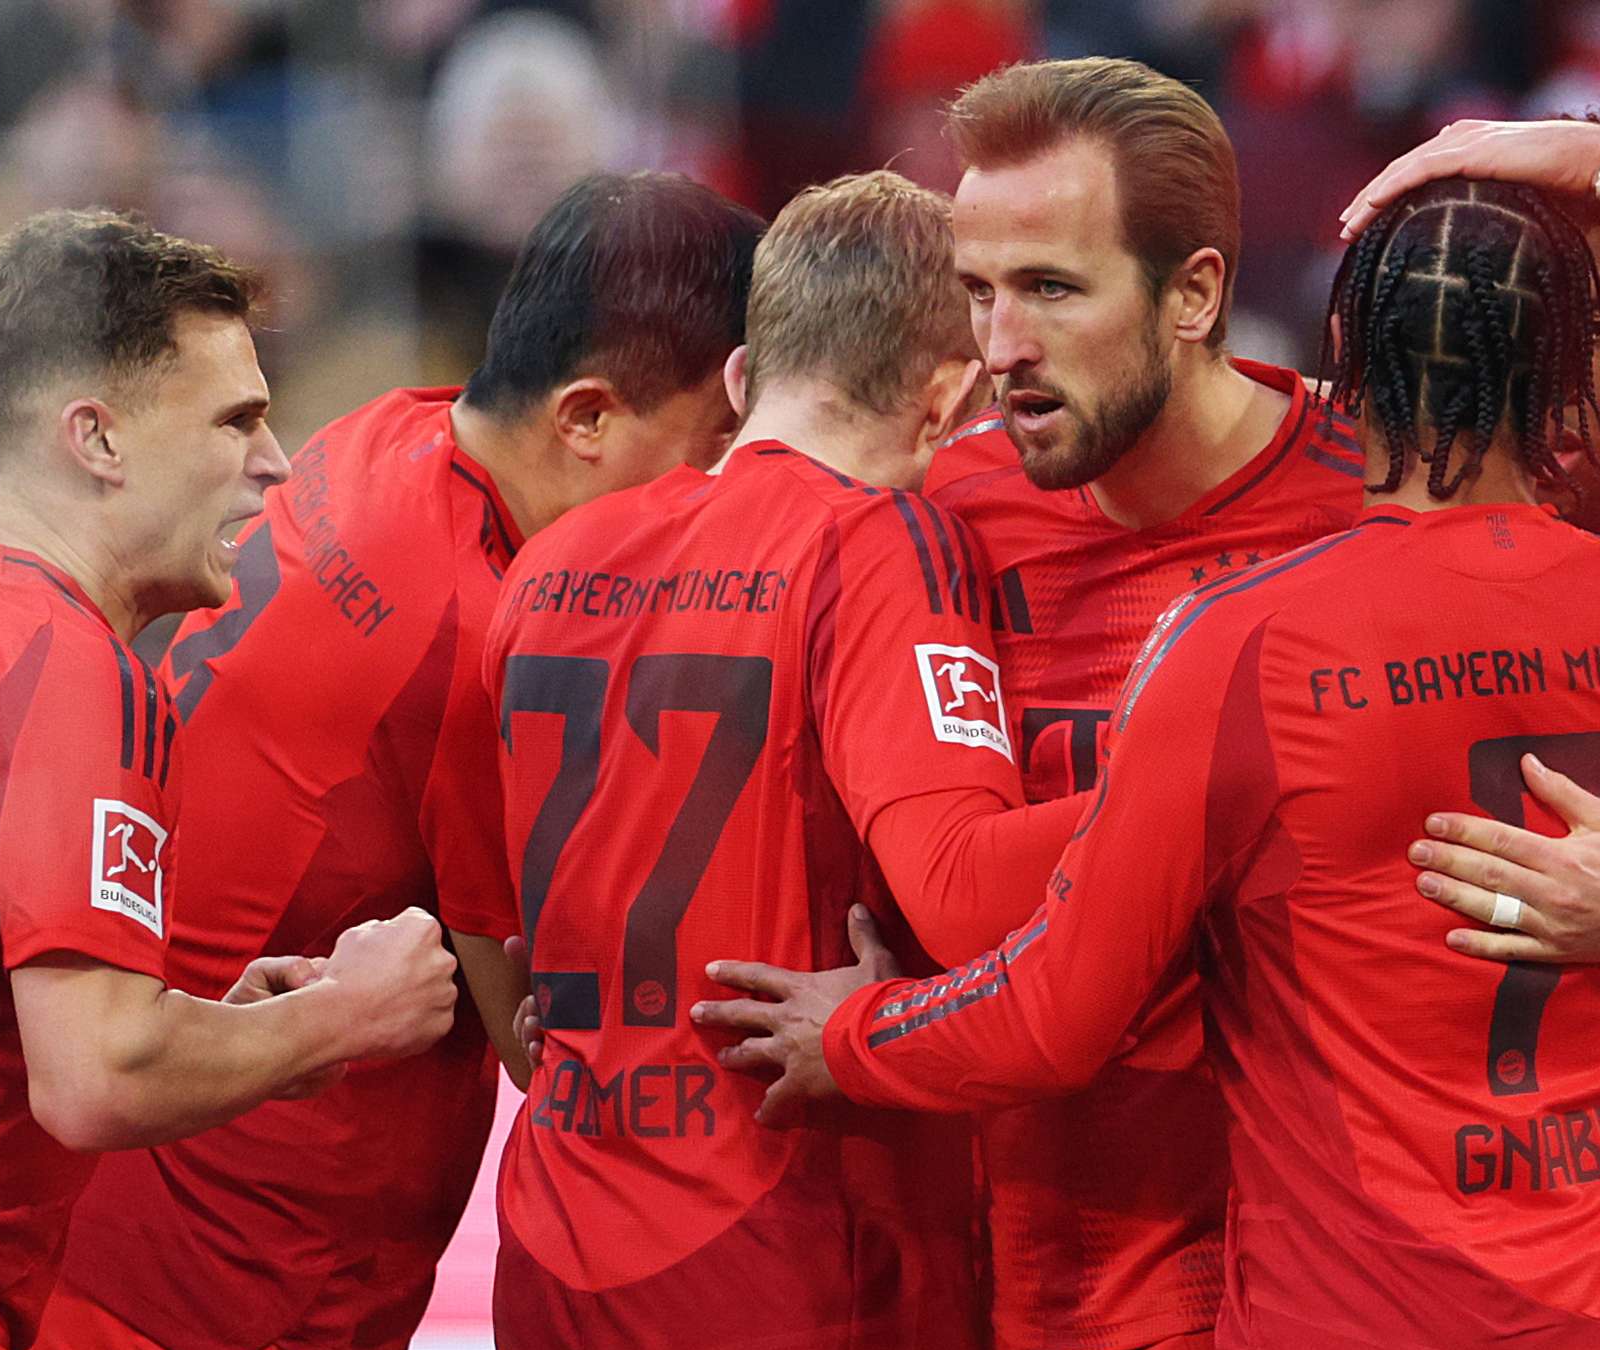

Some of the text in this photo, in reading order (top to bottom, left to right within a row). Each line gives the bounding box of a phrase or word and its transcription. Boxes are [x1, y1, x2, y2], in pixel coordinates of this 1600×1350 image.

[530, 570, 652, 617] BAYERN
[648, 568, 788, 614] MÜNCHEN
[1310, 667, 1369, 714] FC
[1383, 647, 1547, 706] BAYERN
